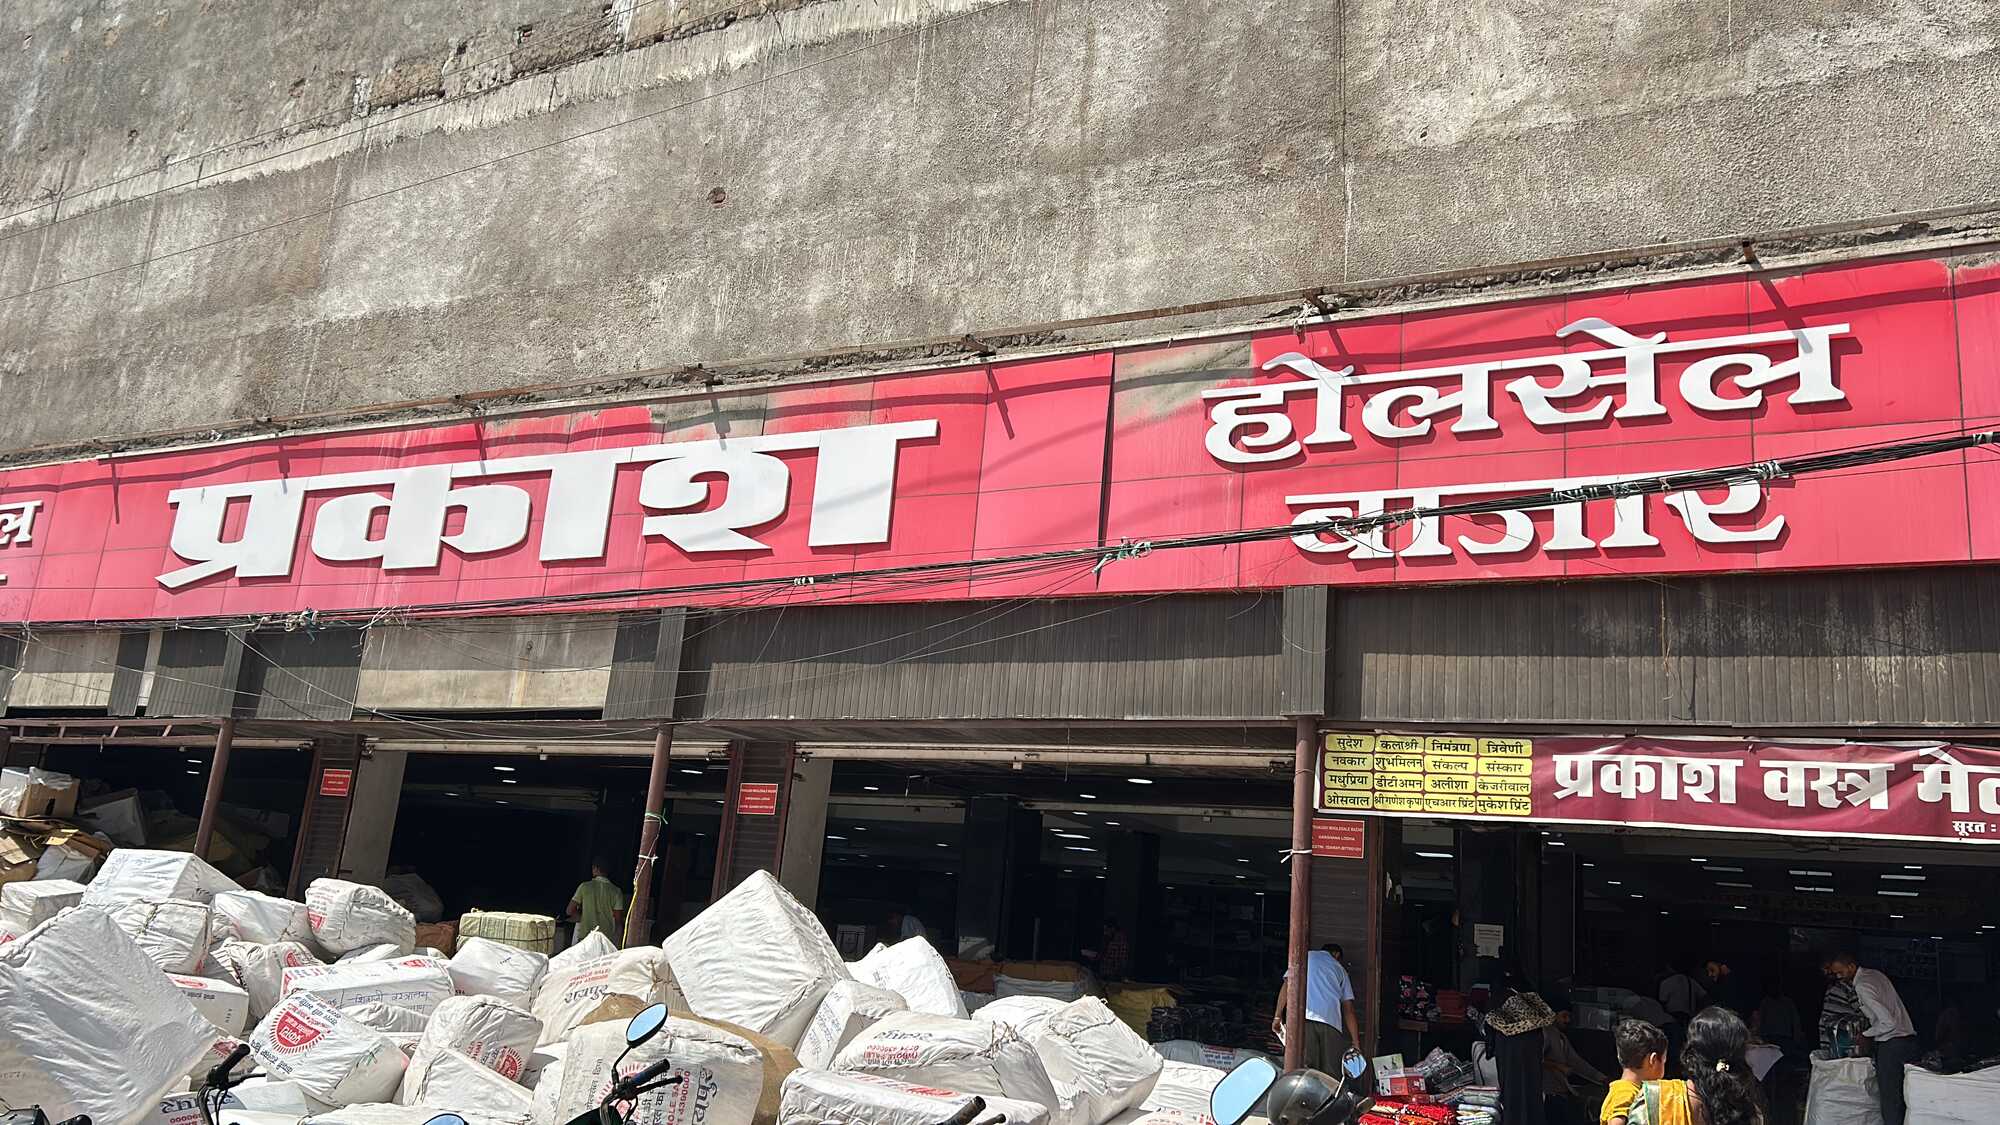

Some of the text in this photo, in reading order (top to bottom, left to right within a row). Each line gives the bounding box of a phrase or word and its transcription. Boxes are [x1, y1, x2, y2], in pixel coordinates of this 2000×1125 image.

[1202, 318, 1851, 463] होलसेल
[156, 419, 939, 588] प्रकाश
[1336, 736, 1363, 750] सुदेश
[1380, 738, 1419, 751] कलाश्री
[1431, 739, 1471, 754] निमंत्रण
[1487, 740, 1524, 755] त्रिवेणी
[1331, 756, 1367, 768] नवकार
[1375, 755, 1423, 771] शुभमिलन
[1431, 758, 1469, 771] संकल्प
[1486, 760, 1524, 773] संस्कार
[1329, 773, 1368, 787] मधुप्रिया
[1430, 777, 1469, 790] अलीशा
[1552, 754, 1744, 804] प्रकाश
[1759, 760, 1895, 810] वस्त्र
[1327, 792, 1370, 806] ओसवाल
[1477, 797, 1530, 812] मुकेश प्रिंट
